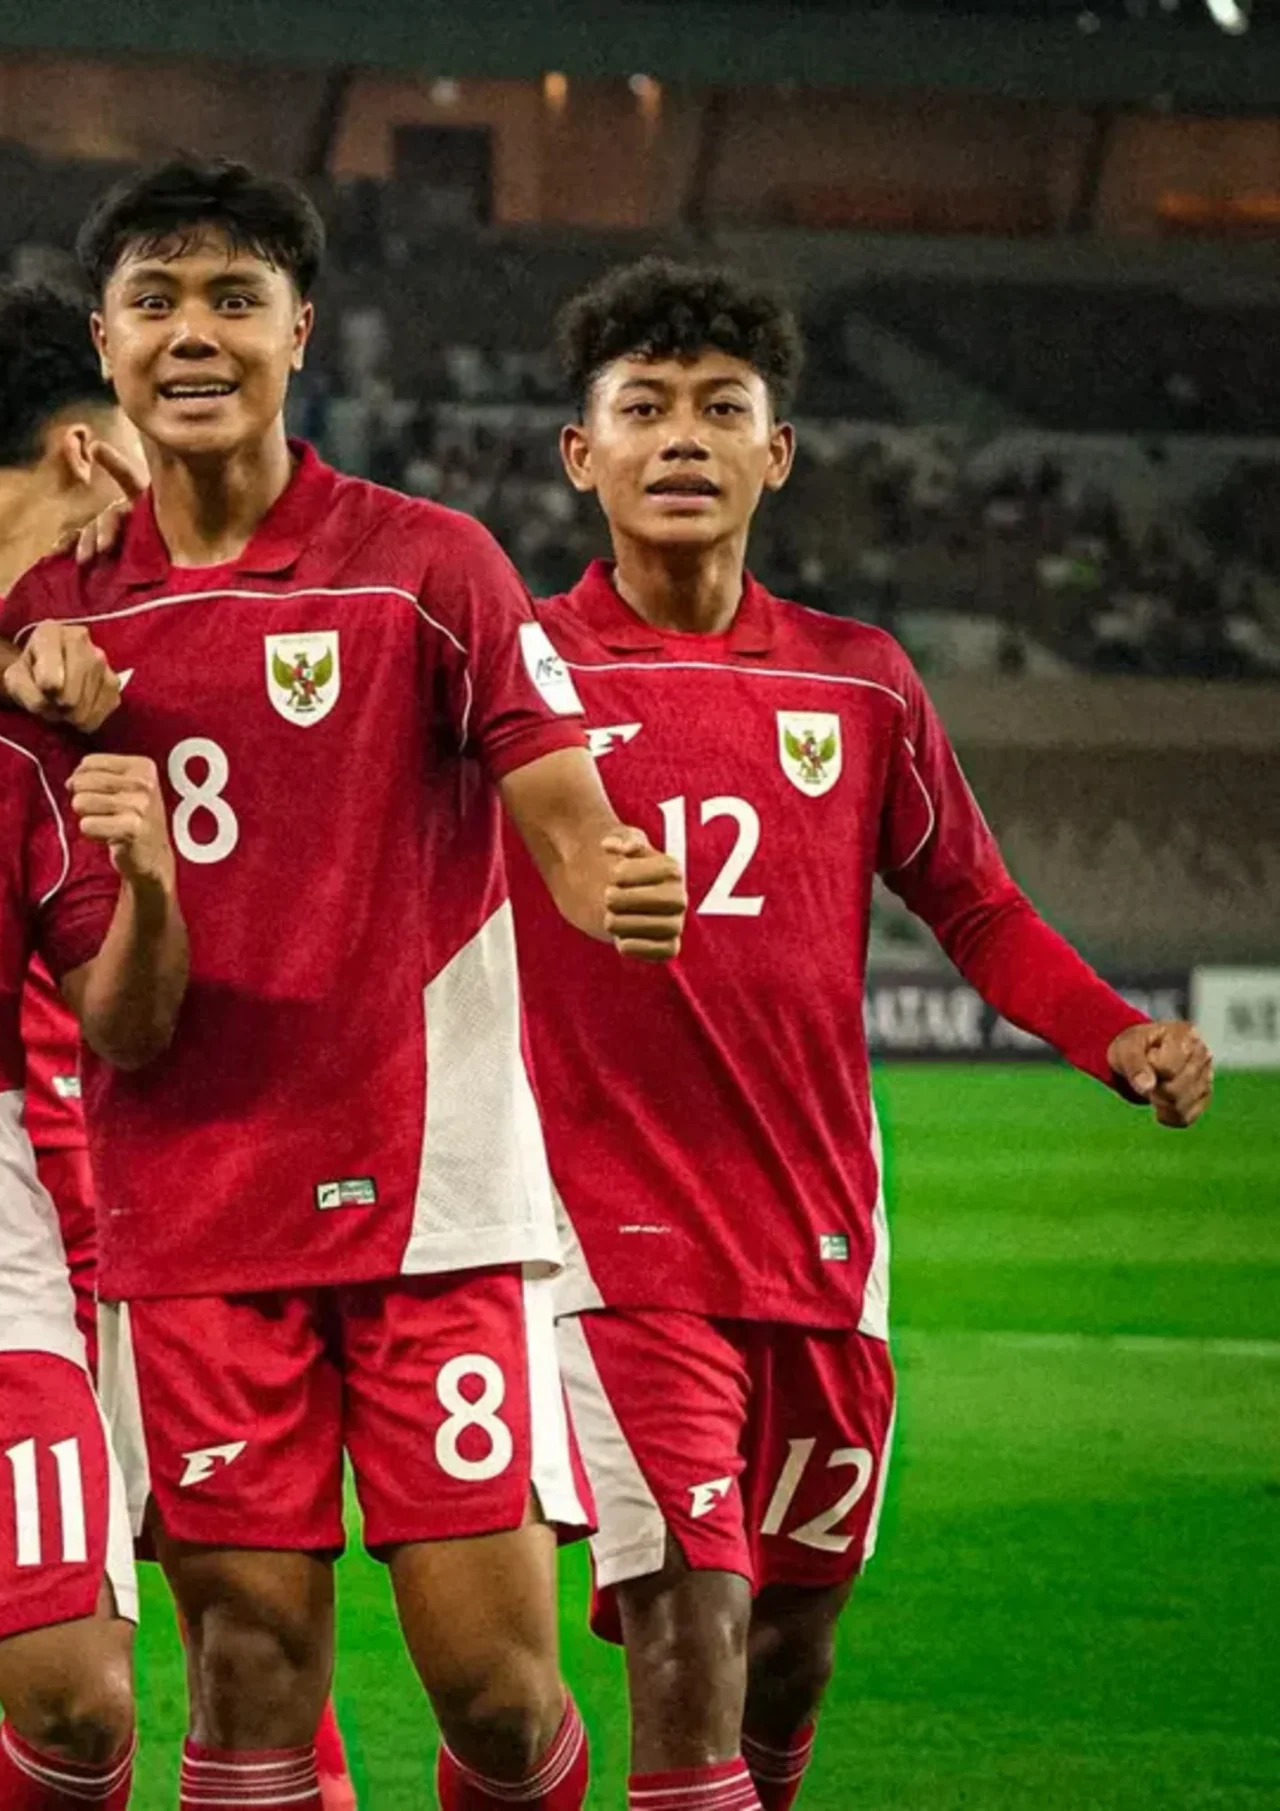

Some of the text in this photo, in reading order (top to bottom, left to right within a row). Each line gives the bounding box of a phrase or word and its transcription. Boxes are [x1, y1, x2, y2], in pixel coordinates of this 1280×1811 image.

[168, 737, 238, 864] 8
[657, 795, 765, 916] 12
[435, 1353, 513, 1481] 8
[5, 1437, 88, 1566] 11
[760, 1437, 874, 1553] 12
